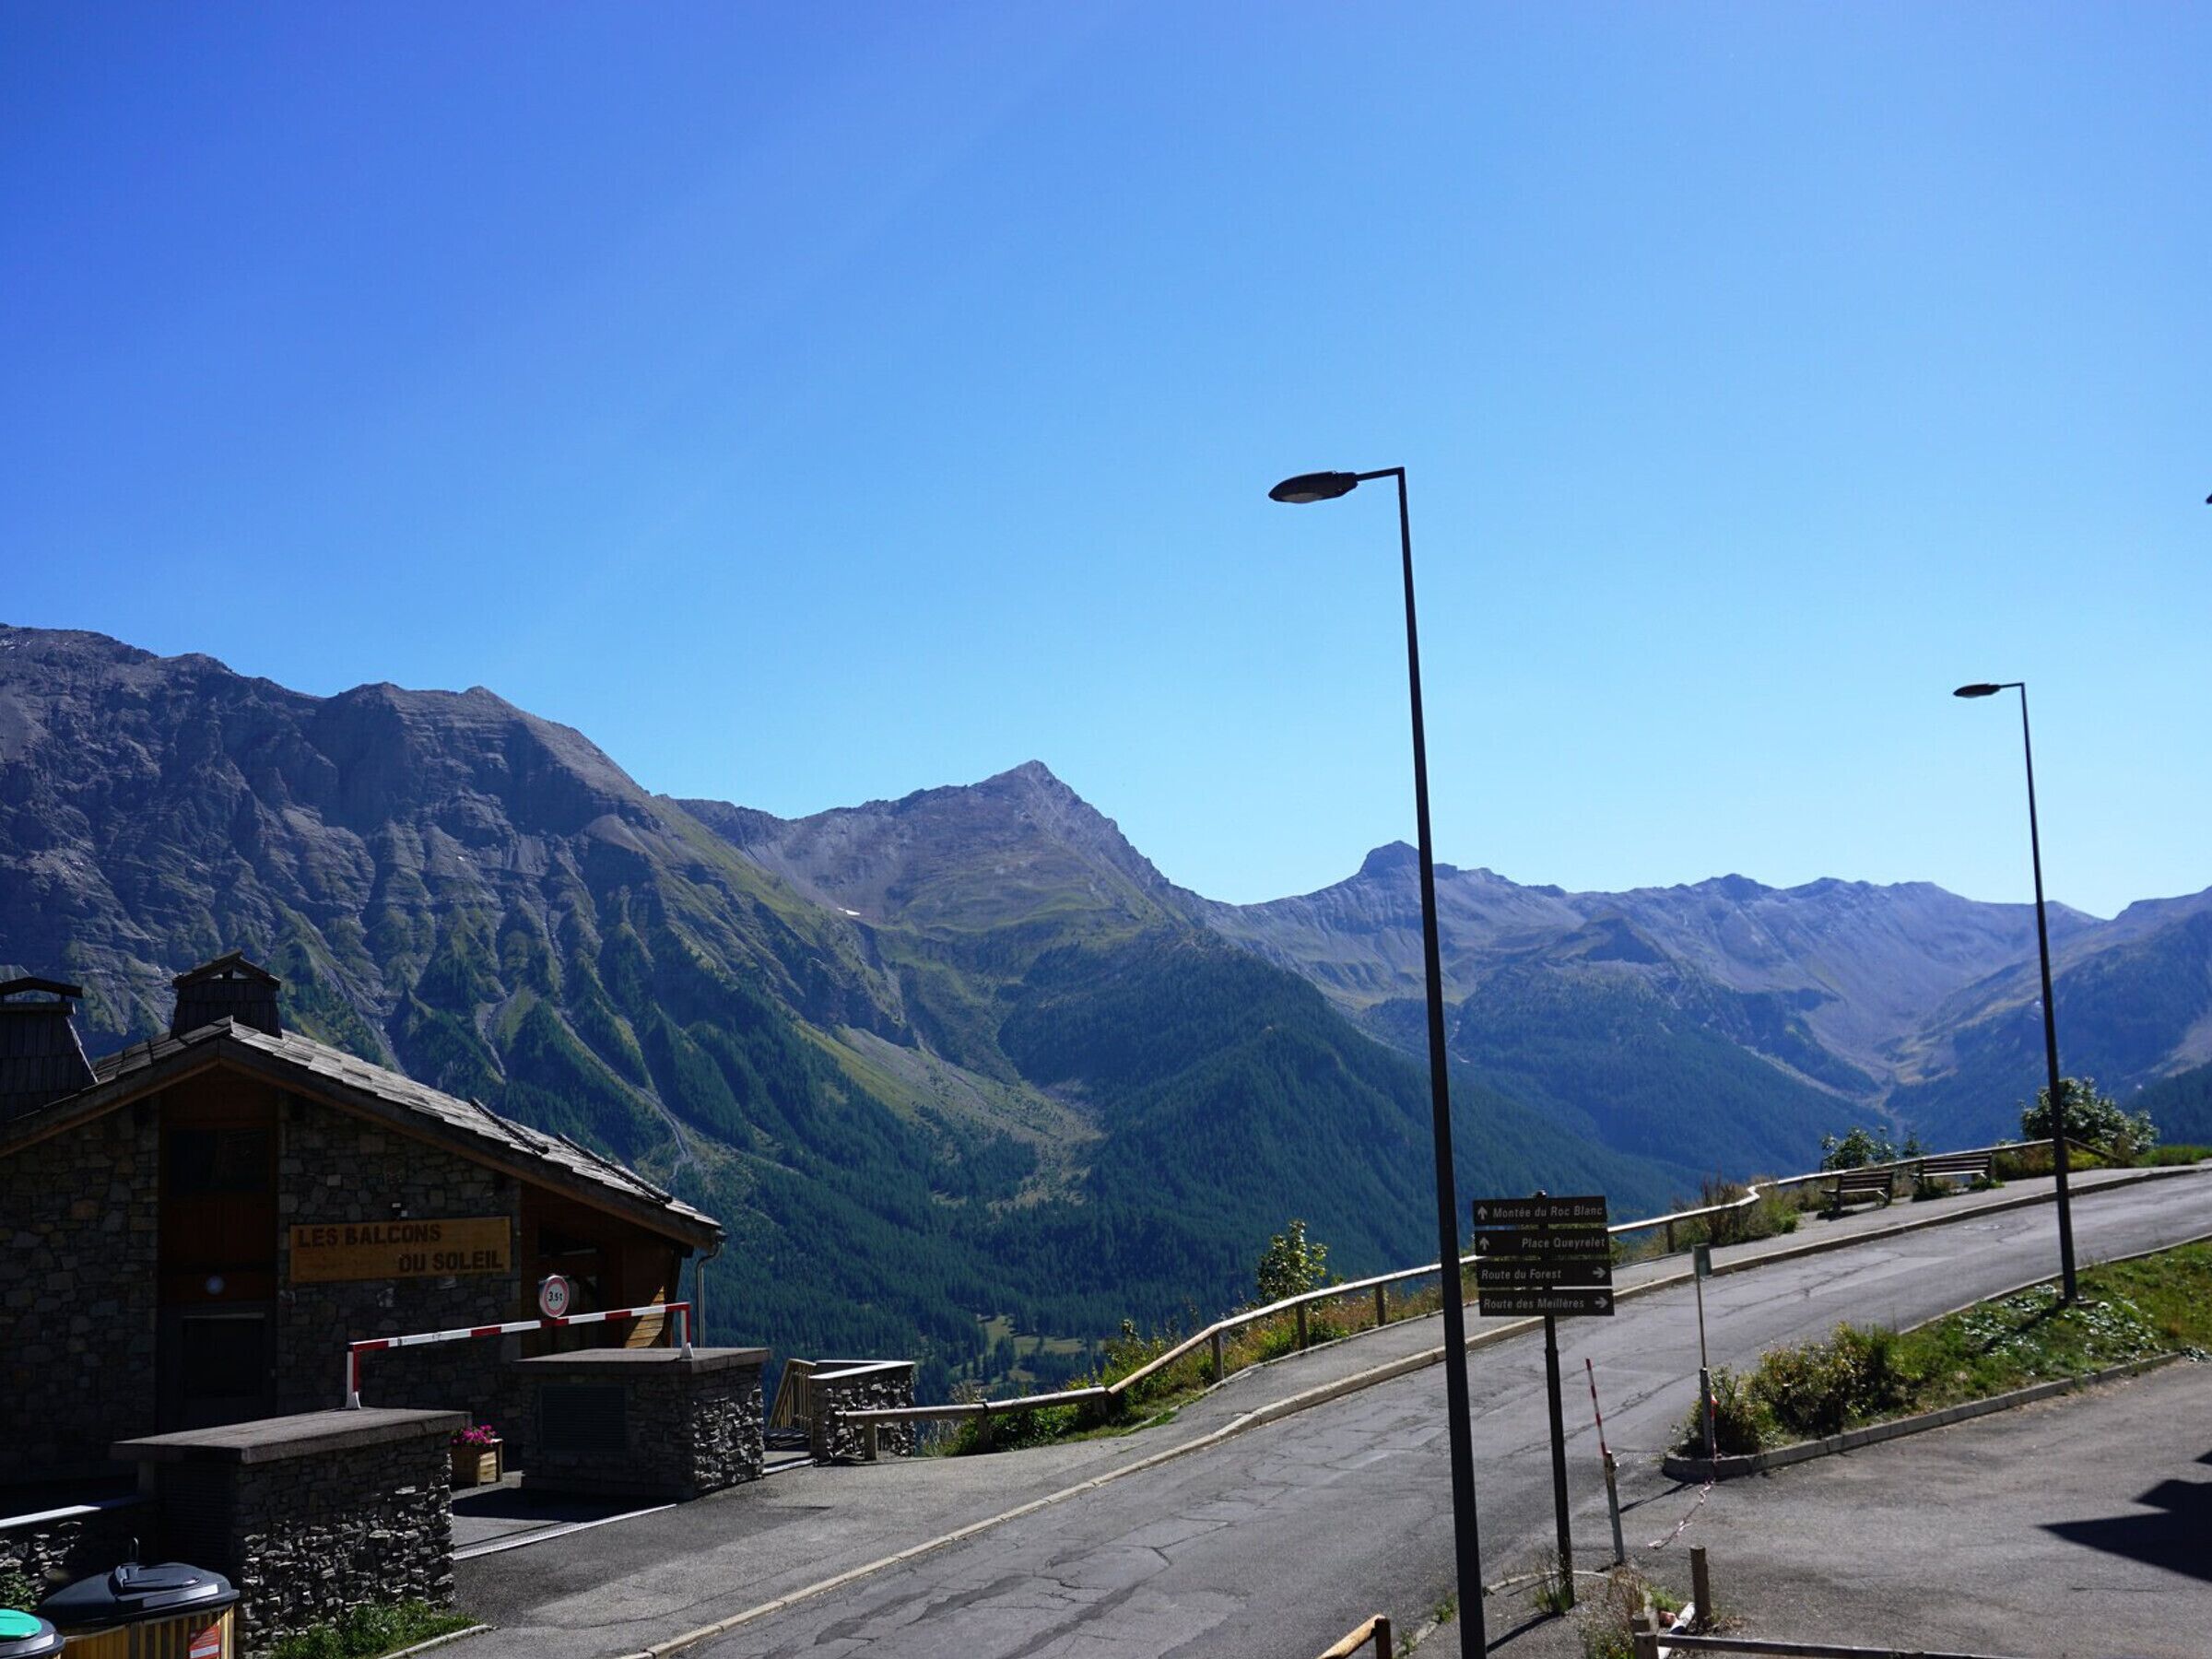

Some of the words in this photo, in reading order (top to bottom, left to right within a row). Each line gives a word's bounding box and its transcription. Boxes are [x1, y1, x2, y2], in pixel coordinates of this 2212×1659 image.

[1493, 1206, 1531, 1218] Montée
[1535, 1206, 1547, 1218] du
[1550, 1206, 1570, 1217] Roc
[1573, 1205, 1603, 1217] Blanc
[297, 1228, 338, 1248] LES
[345, 1223, 441, 1245] BALCONS
[1522, 1238, 1549, 1249] Place
[1553, 1237, 1605, 1250] Queyrelet
[432, 1250, 503, 1271] SOLEIL
[1481, 1268, 1511, 1279] Route
[1514, 1269, 1526, 1279] du
[1529, 1268, 1561, 1279] Forest
[1483, 1298, 1512, 1309] Route
[1516, 1298, 1534, 1309] des
